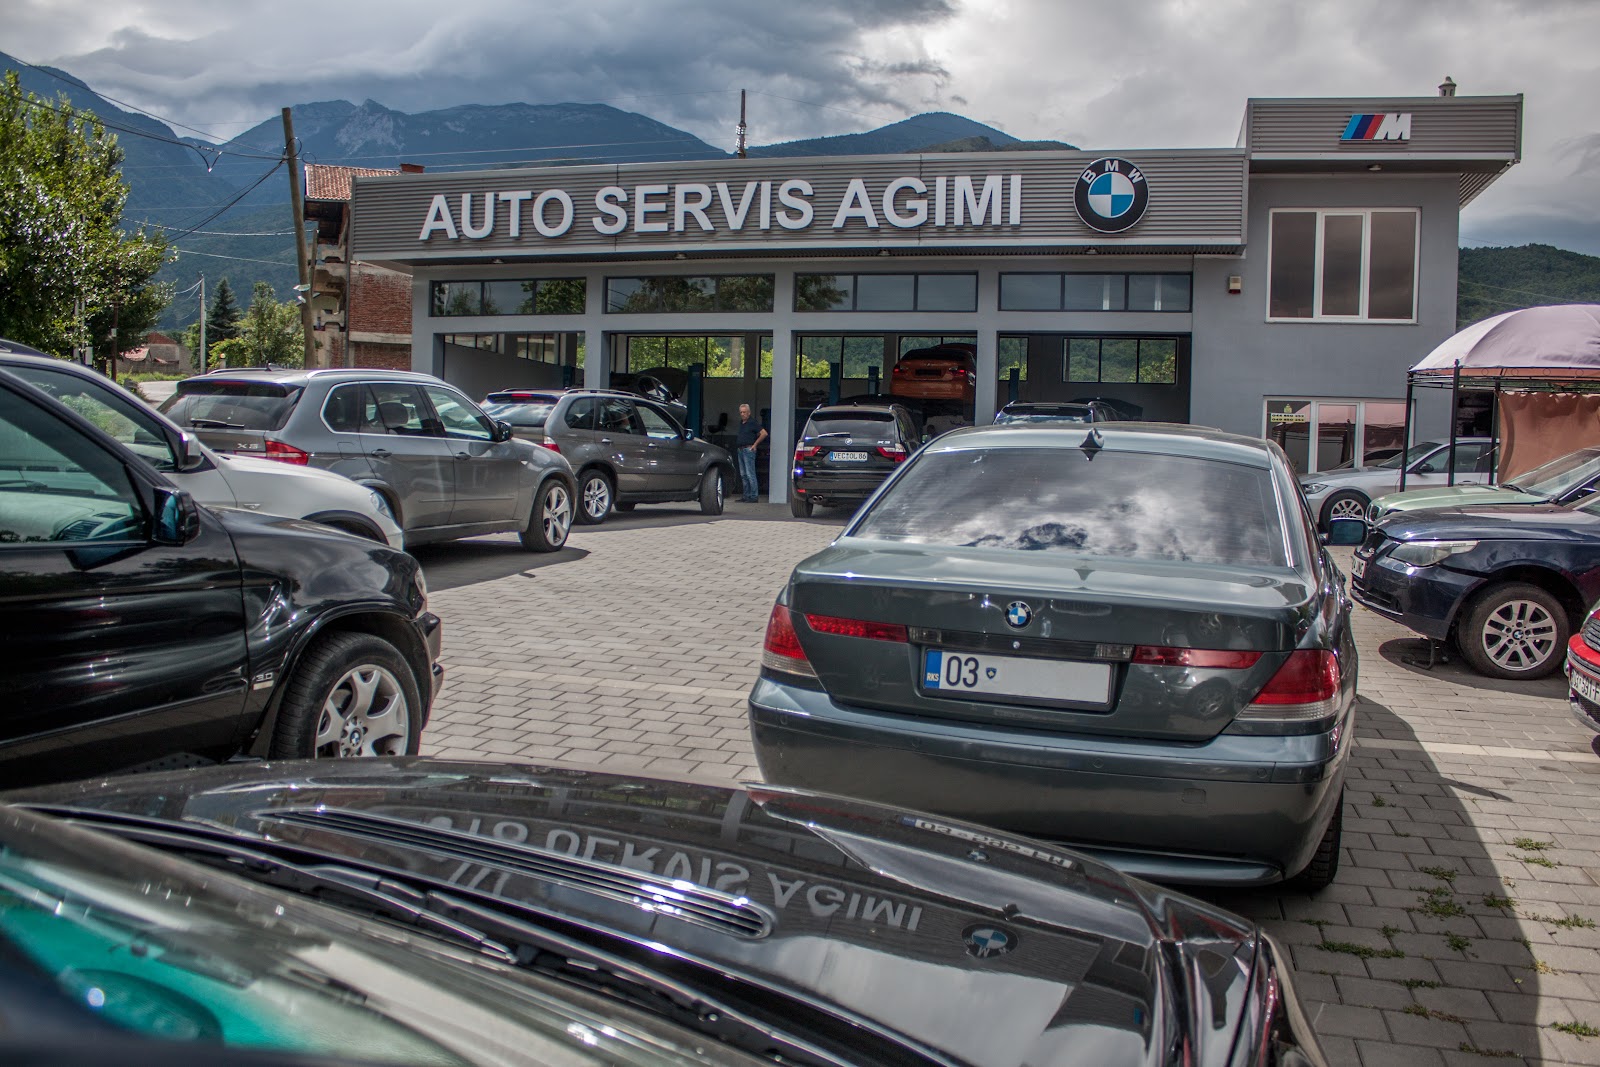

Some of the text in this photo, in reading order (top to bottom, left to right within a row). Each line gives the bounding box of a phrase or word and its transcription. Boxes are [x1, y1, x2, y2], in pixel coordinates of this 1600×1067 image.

[1373, 113, 1412, 140] M
[419, 174, 1022, 240] AUTO SERVIS AGIMI
[833, 452, 867, 460] VEC OL 86
[926, 672, 939, 682] RKS
[945, 655, 980, 688] 03
